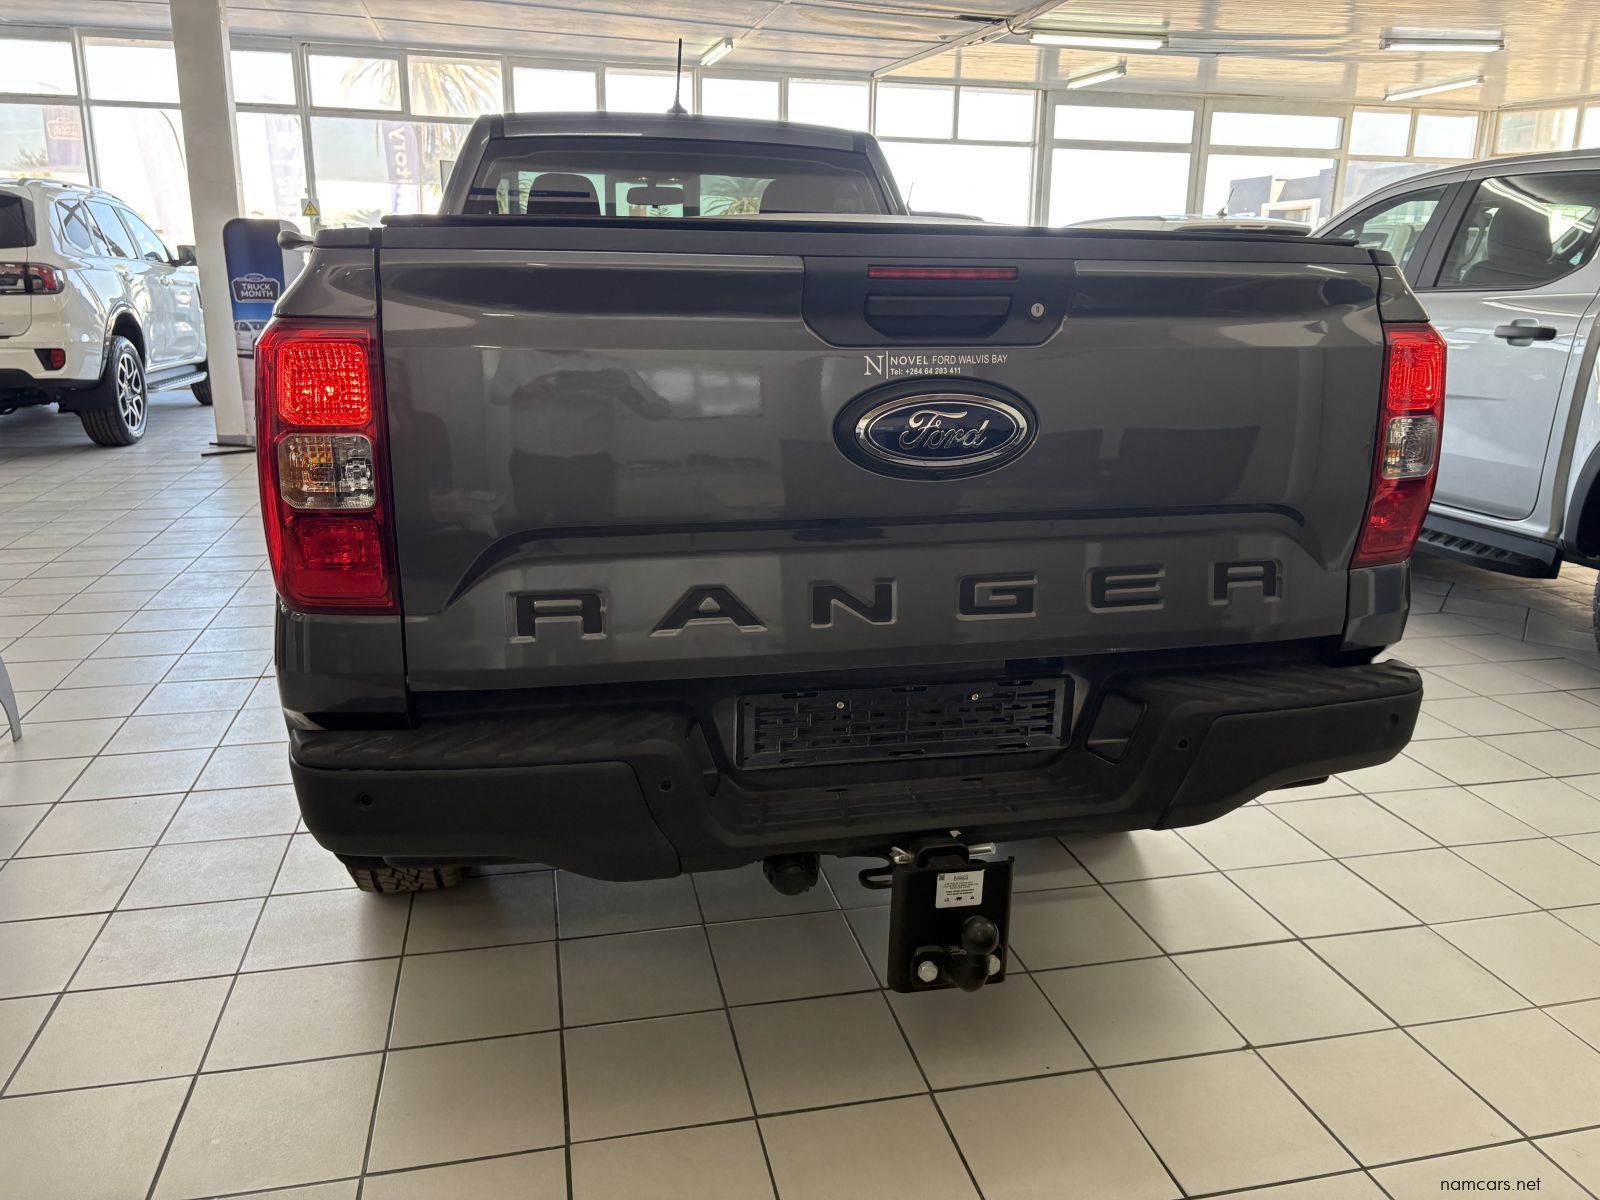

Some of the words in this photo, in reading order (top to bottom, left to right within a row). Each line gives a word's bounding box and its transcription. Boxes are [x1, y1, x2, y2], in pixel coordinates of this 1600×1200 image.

[890, 355, 928, 365] NOVEL
[932, 355, 957, 365] FORD
[958, 354, 990, 364] WALVIS
[991, 354, 1008, 364] BAY
[890, 368, 904, 376] Tel:
[924, 367, 933, 375] 64
[934, 367, 948, 375] 203
[899, 410, 989, 450] Ford
[507, 557, 1284, 645] RANGER
